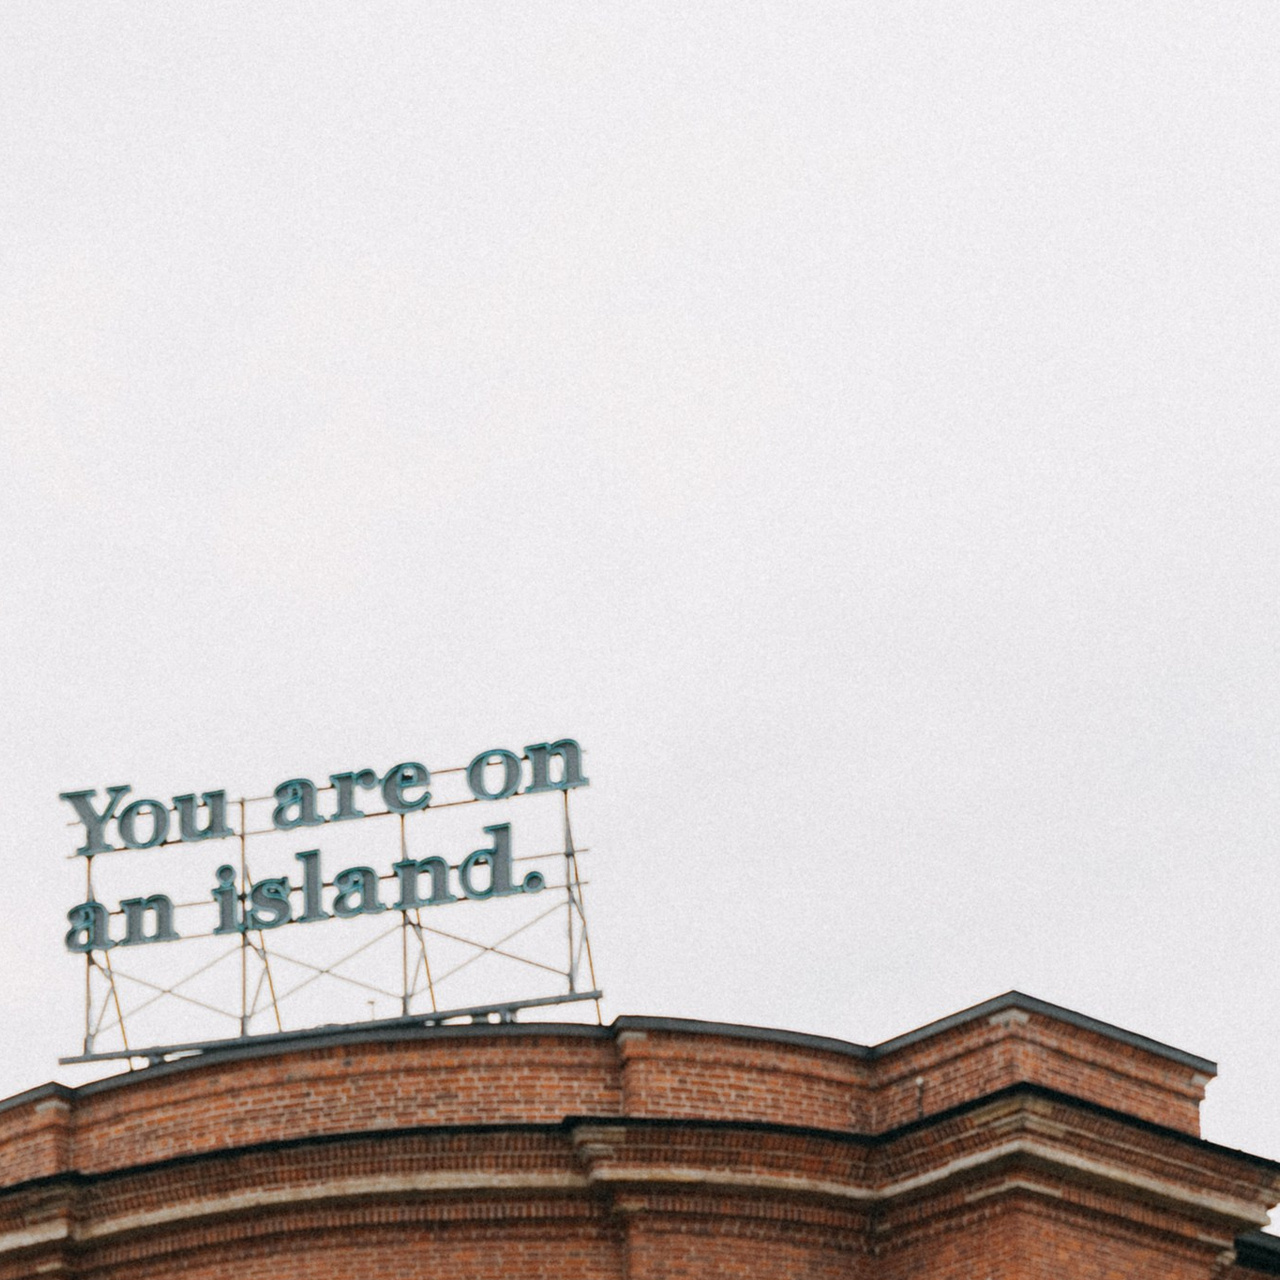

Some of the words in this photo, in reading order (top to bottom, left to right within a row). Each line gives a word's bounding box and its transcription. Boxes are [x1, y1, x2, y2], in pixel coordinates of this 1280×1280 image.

[60, 784, 233, 857] You
[272, 761, 432, 832] are
[466, 738, 589, 801] on
[65, 893, 180, 953] an
[213, 822, 545, 936] island.
